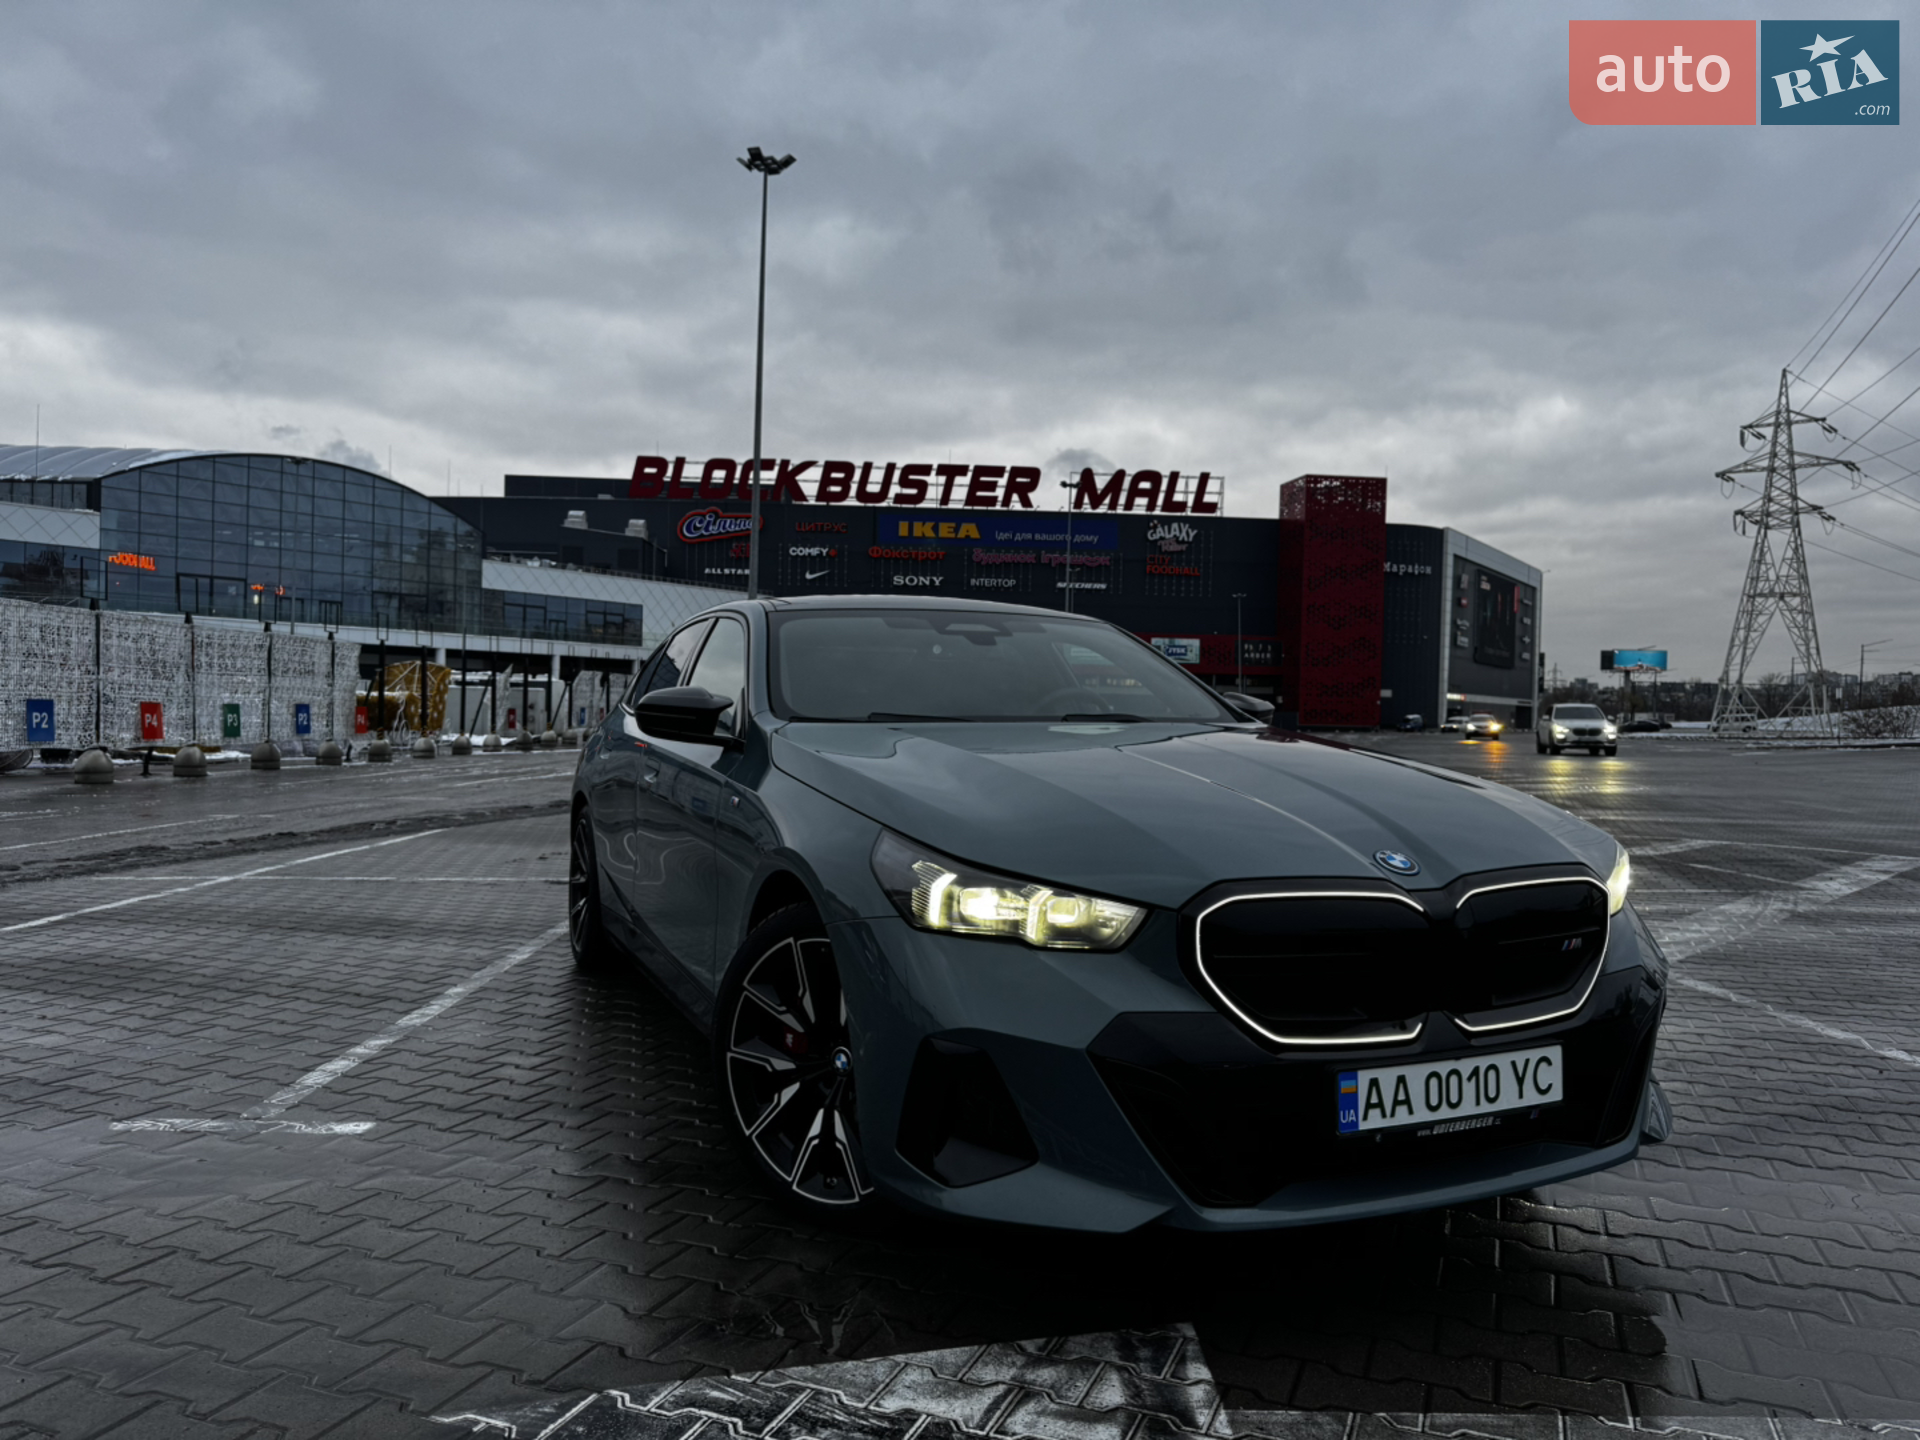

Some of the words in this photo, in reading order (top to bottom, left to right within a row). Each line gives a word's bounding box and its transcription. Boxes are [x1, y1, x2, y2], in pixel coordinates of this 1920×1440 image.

[629, 456, 1041, 509] BLOCKBUSTER
[1073, 467, 1219, 514] MALL
[796, 522, 848, 533] ЦИТРУС
[898, 520, 981, 539] IKEA
[1147, 521, 1199, 542] GALAXY
[995, 530, 1013, 540] Ідеї
[1014, 532, 1032, 541] для
[1034, 533, 1072, 543] вашого
[1073, 533, 1099, 545] дому
[789, 546, 829, 557] COMFY
[867, 545, 947, 561] Фокстрот
[1146, 554, 1171, 565] CITY
[1146, 565, 1200, 576] FOODHALL
[893, 575, 944, 586] SONY
[970, 578, 1016, 588] INTERTOP
[32, 712, 48, 728] P2
[144, 713, 158, 727] P4
[227, 713, 238, 727] P3
[298, 713, 308, 725] P2
[1340, 1109, 1356, 1123] UA
[1362, 1074, 1414, 1121] AA
[1425, 1063, 1500, 1112] 0010
[1511, 1056, 1553, 1099] YC
